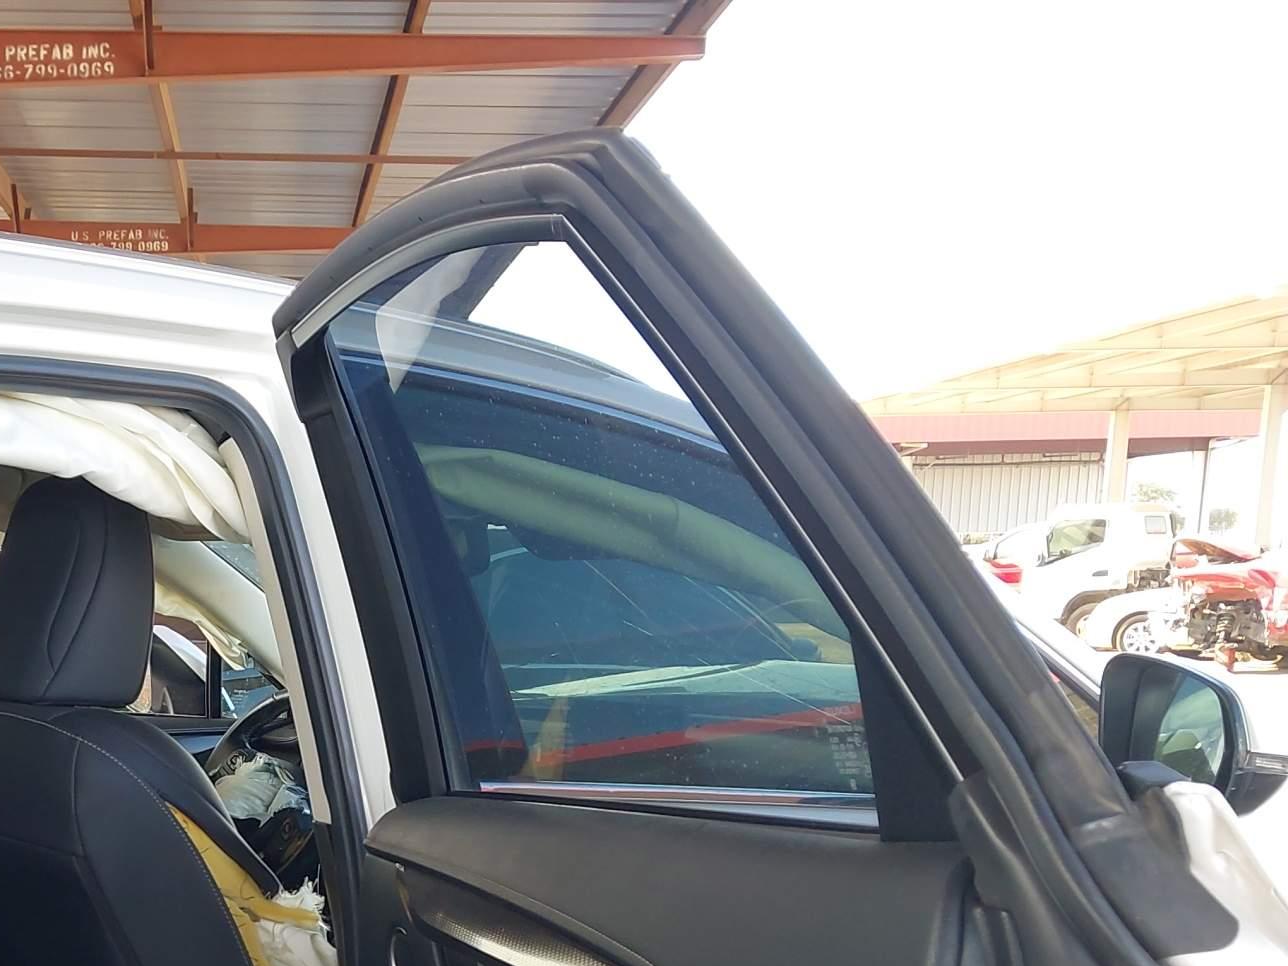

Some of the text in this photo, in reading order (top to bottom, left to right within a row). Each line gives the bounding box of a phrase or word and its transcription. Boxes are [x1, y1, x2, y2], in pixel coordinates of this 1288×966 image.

[5, 43, 74, 62] PREFAB
[82, 42, 116, 59] INC.
[98, 229, 144, 241] PREFAB
